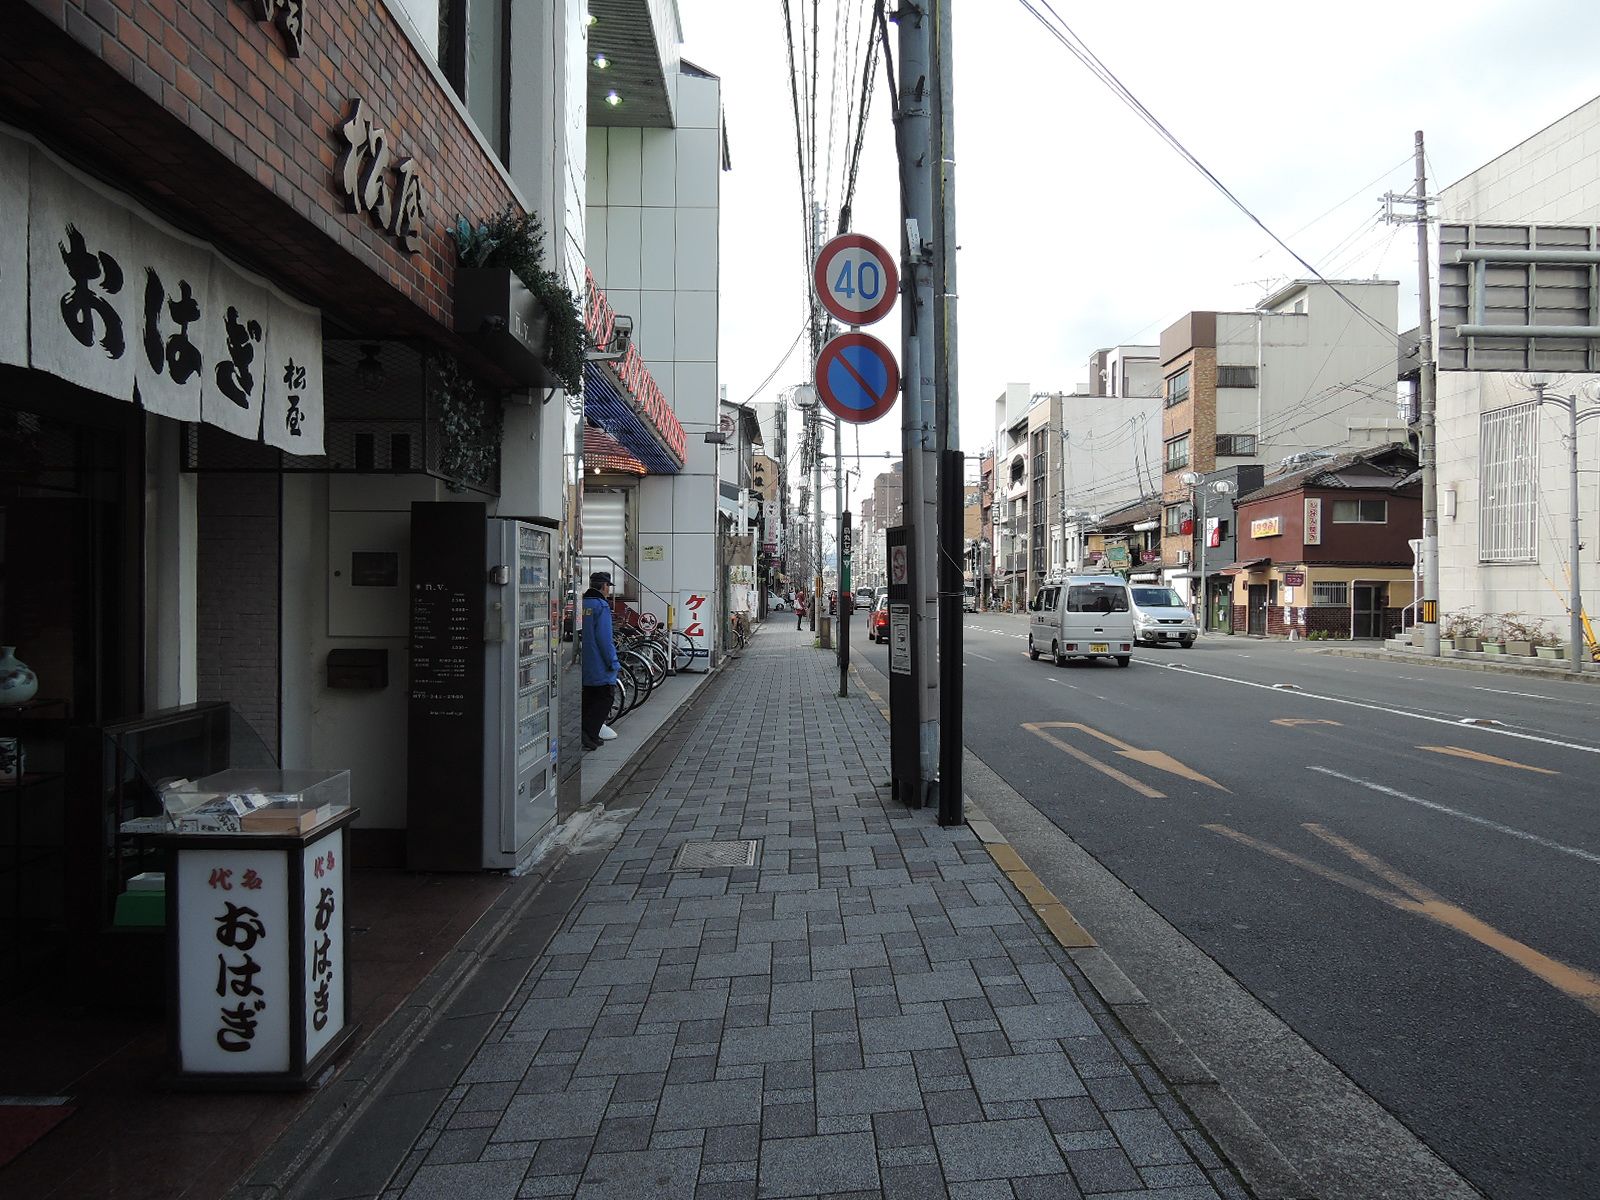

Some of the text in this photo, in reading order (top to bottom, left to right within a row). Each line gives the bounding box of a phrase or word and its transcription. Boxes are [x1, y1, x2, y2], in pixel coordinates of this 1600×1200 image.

[58, 222, 262, 409] おはぎ
[834, 259, 879, 300] 40
[283, 357, 307, 437] 松屋
[214, 901, 267, 1053] おはぎ
[313, 887, 336, 1032] おはぎ
